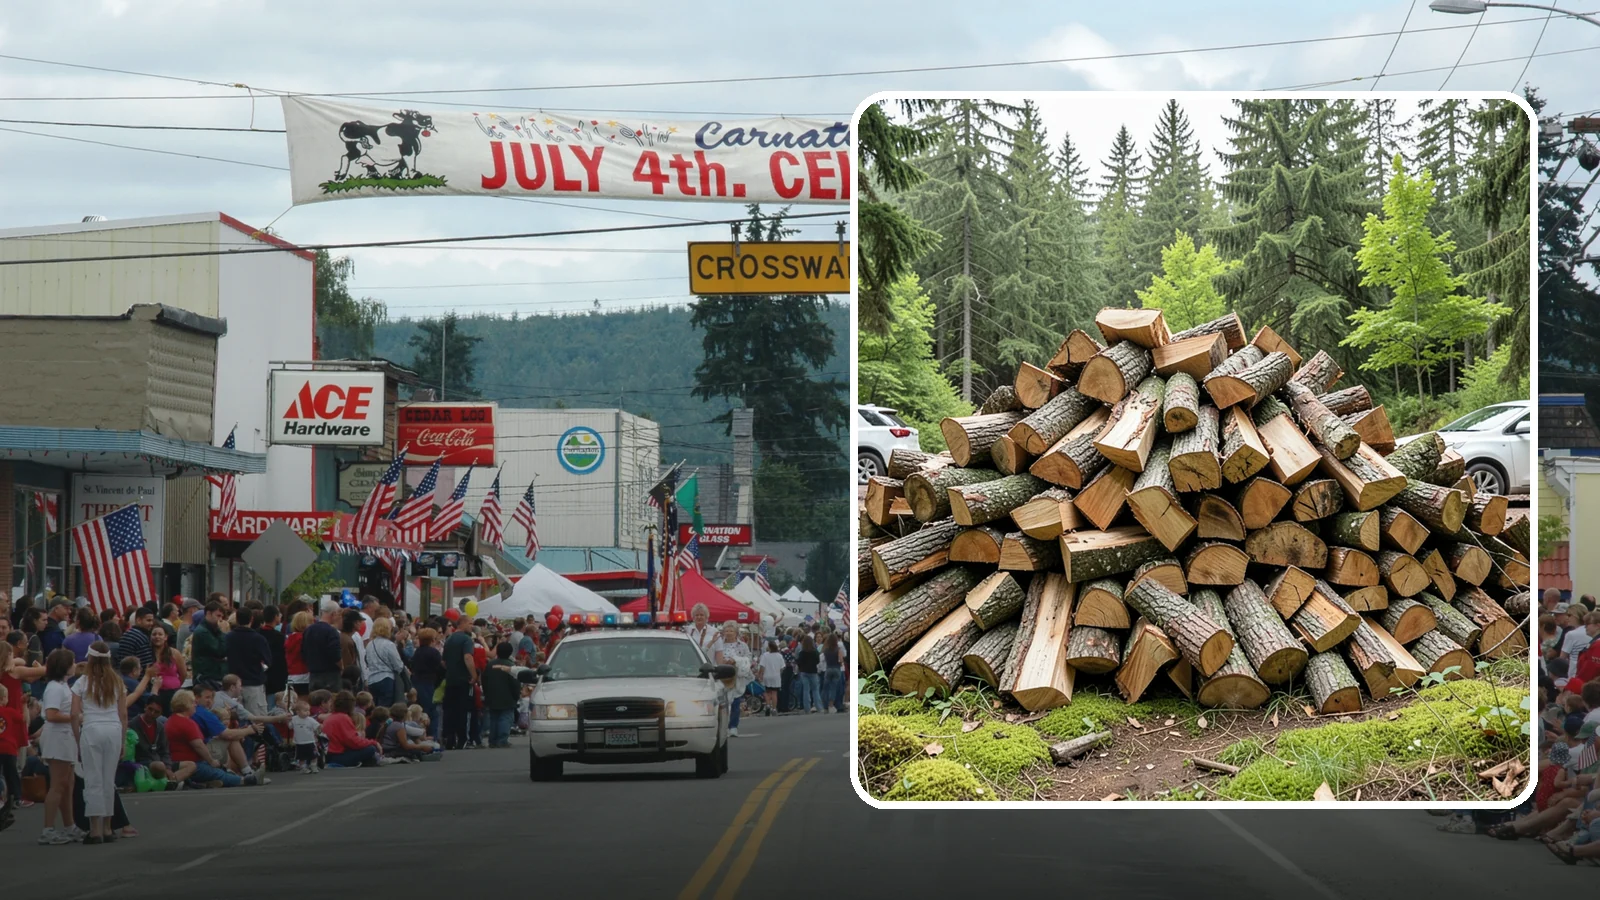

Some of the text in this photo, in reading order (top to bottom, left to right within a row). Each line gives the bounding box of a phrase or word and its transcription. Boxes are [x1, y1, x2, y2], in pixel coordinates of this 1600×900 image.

[481, 141, 605, 192] JULY
[632, 150, 746, 198] 4th.
[697, 254, 850, 280] CROSSWA
[283, 380, 374, 420] ACE
[405, 409, 452, 422] CEDAR
[283, 421, 371, 436] Hardware
[354, 467, 385, 479] Simpl
[83, 485, 155, 495] St. Vincent de Paul
[81, 503, 154, 522] THT
[688, 526, 741, 535] CRNATION
[699, 535, 730, 543] GLASS
